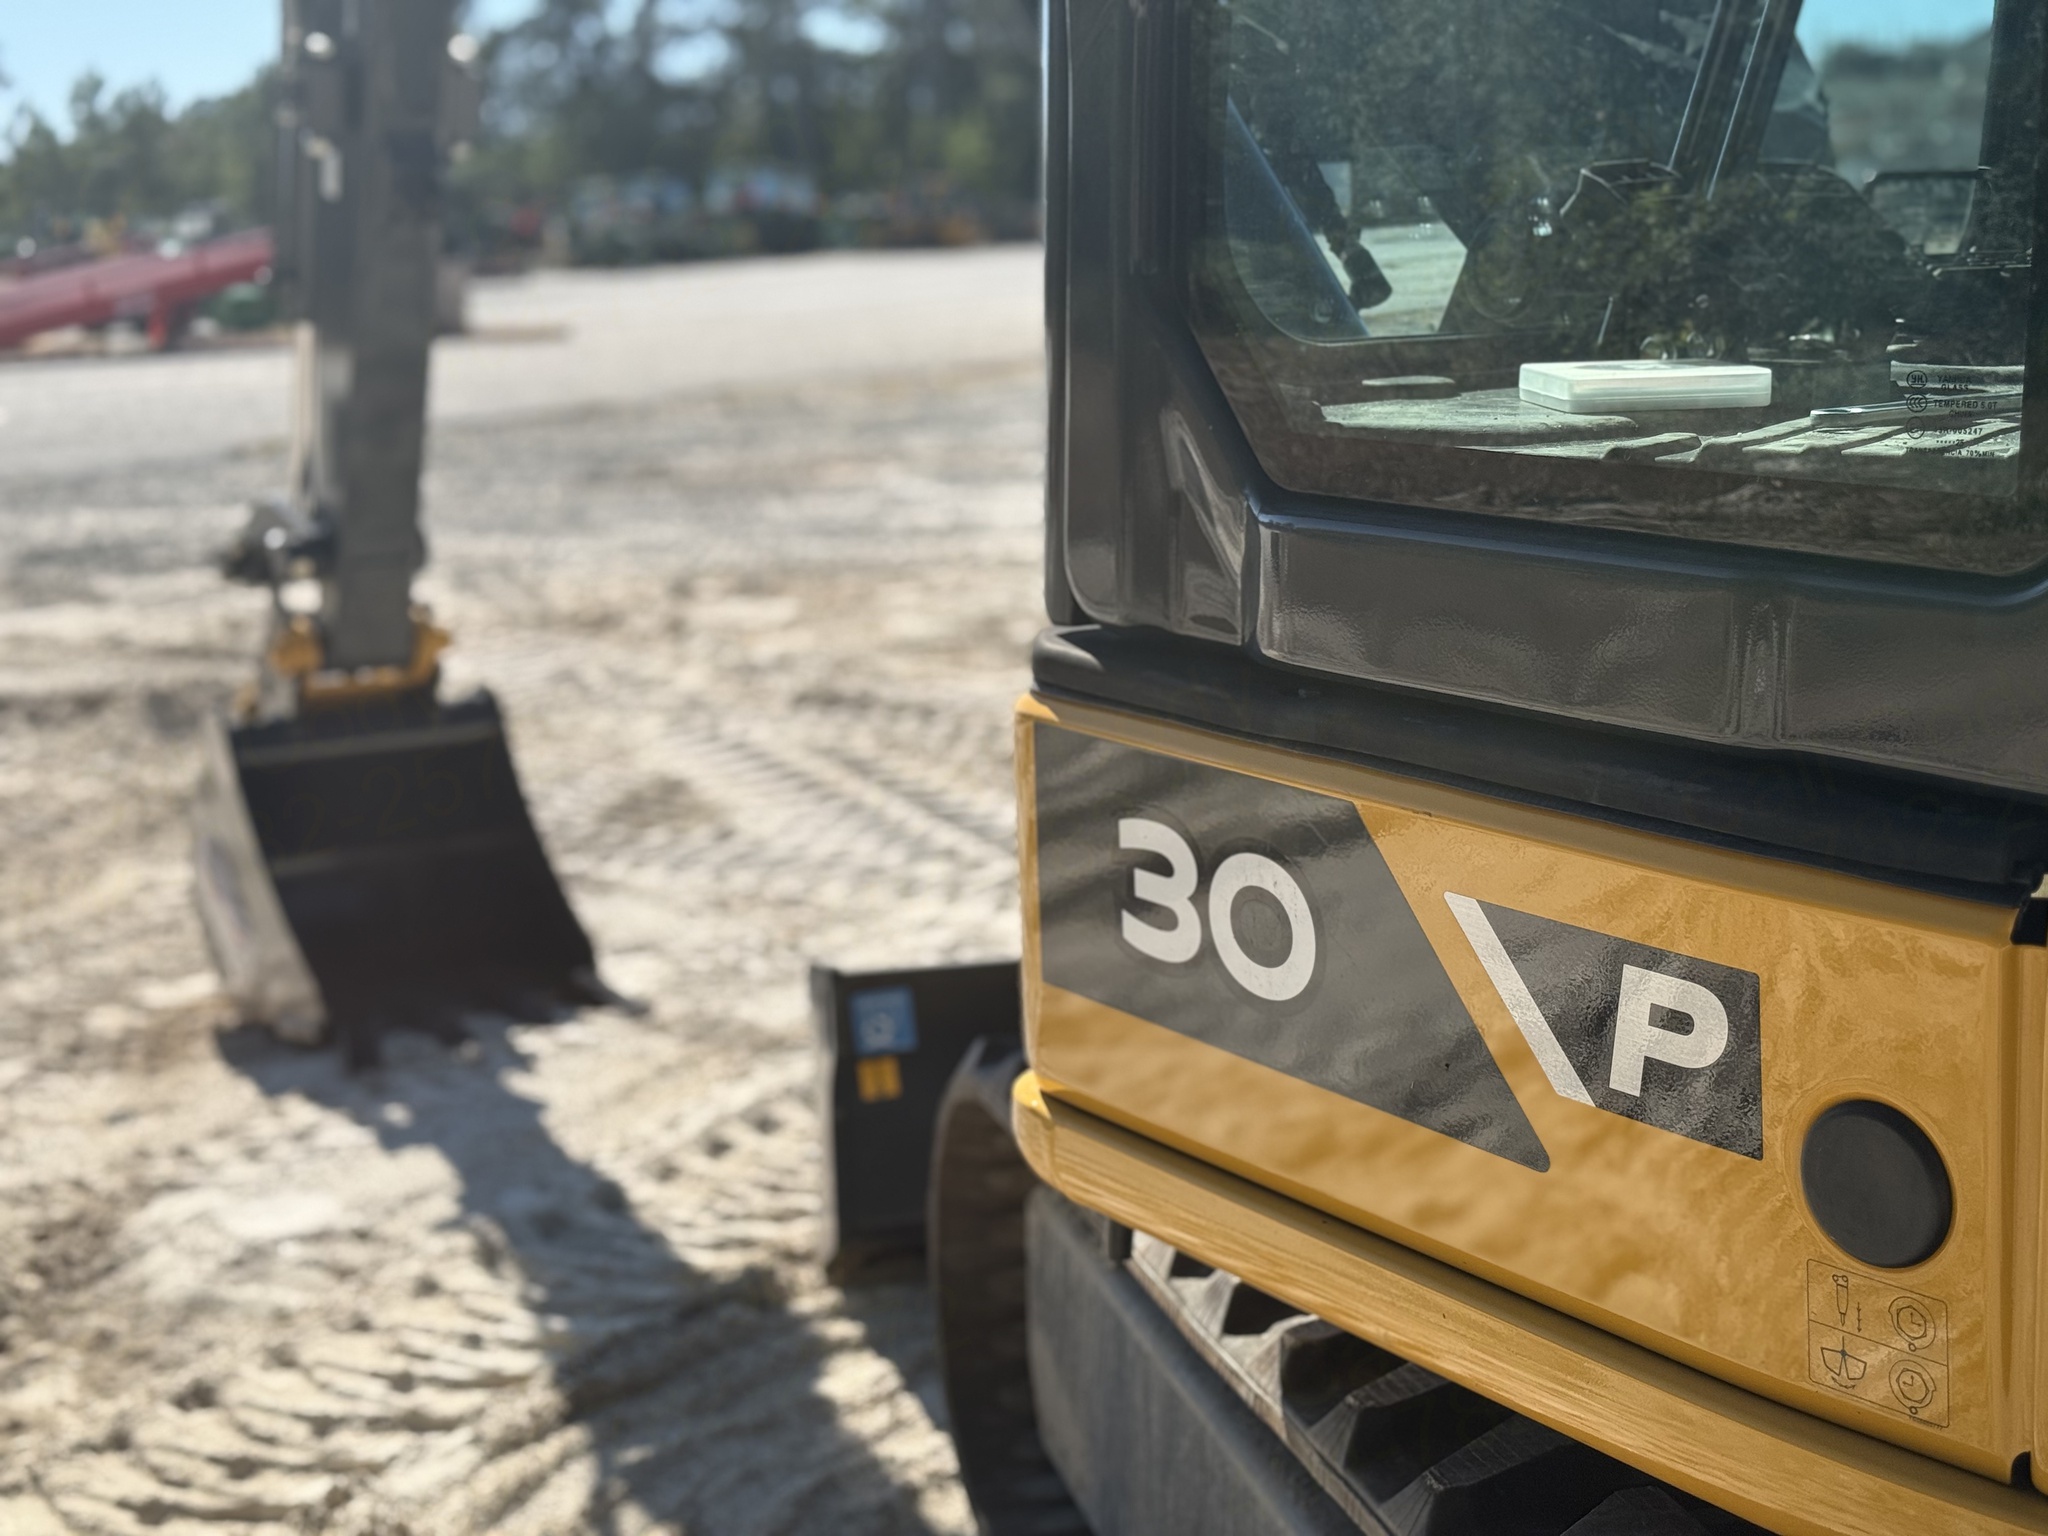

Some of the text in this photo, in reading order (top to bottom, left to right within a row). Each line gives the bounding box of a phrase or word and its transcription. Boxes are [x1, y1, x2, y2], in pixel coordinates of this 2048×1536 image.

[1933, 399, 1978, 409] TEMPERED
[1941, 383, 1969, 391] GLASS
[1118, 817, 1316, 1001] 30
[1609, 963, 1729, 1098] P
